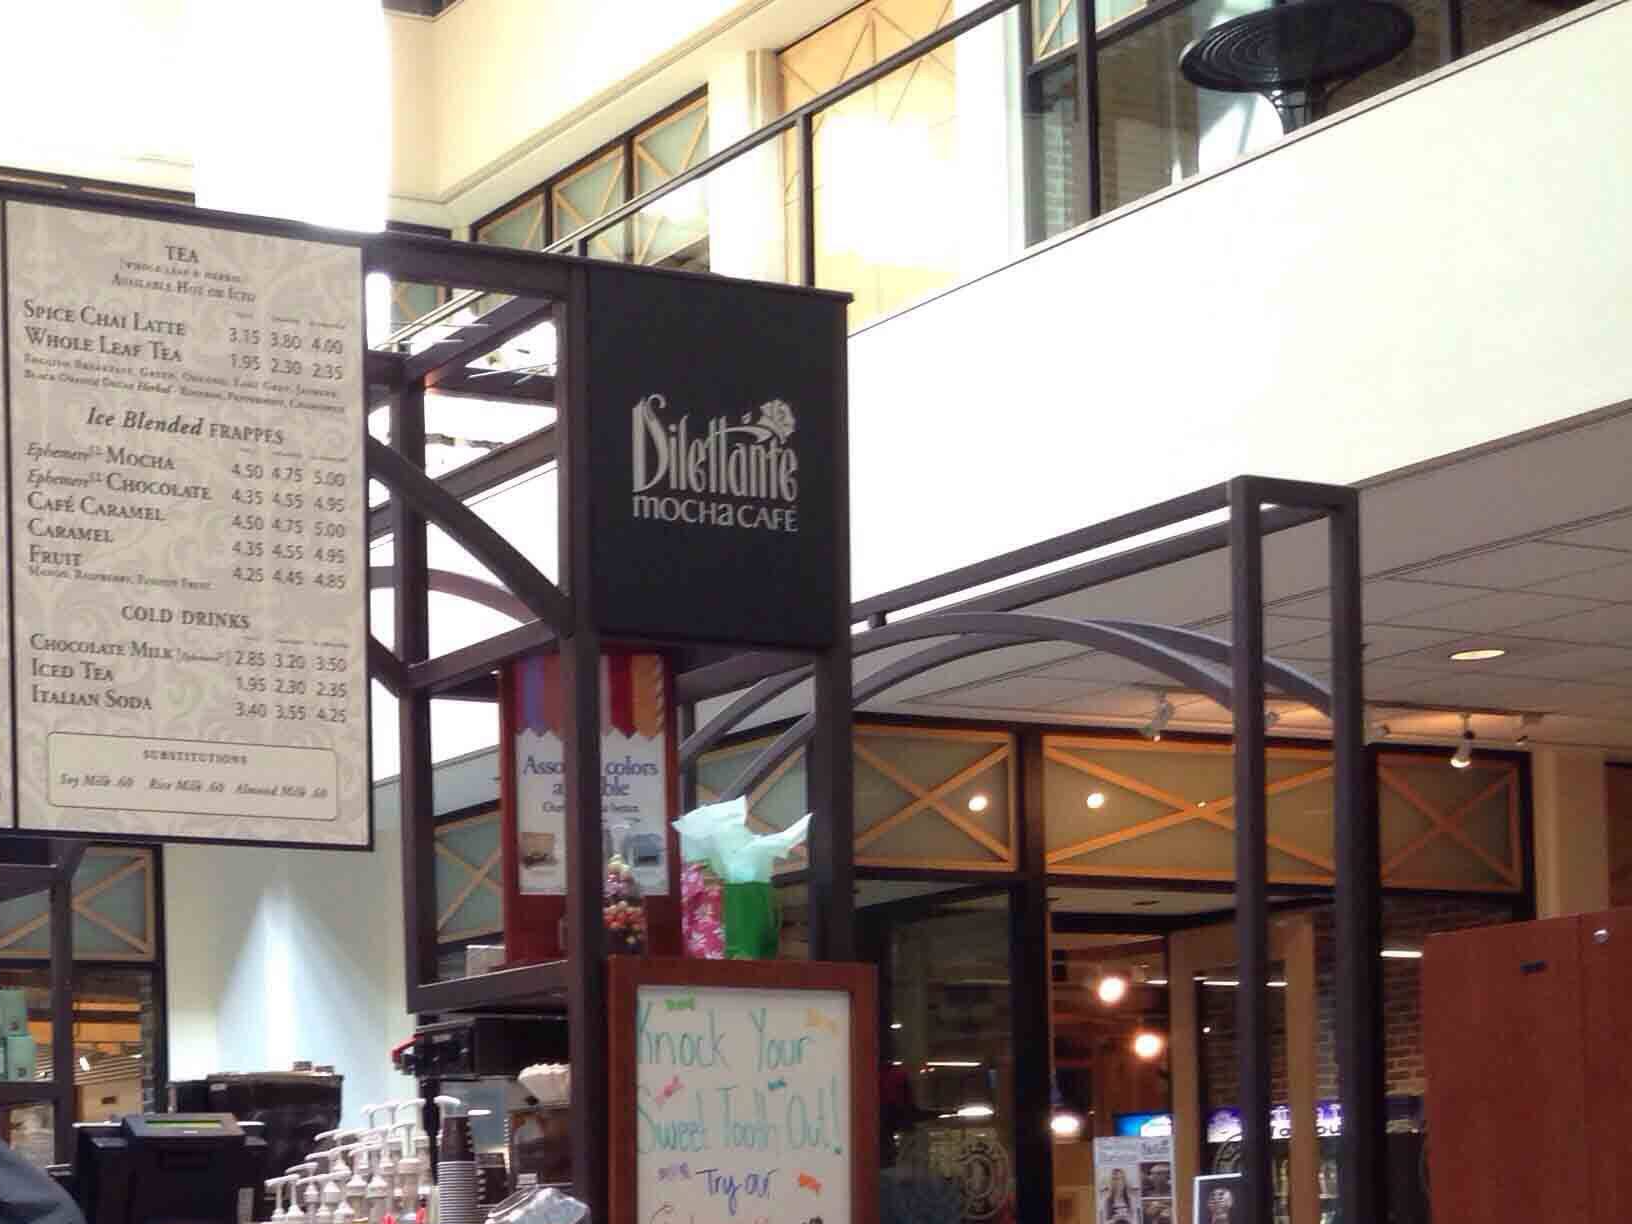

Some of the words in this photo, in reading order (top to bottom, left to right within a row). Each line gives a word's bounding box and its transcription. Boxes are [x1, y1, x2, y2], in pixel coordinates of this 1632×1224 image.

[165, 245, 200, 264] TEA
[24, 299, 75, 324] SPICE
[80, 305, 126, 330] CHAI
[133, 312, 187, 337] LATTE
[25, 326, 94, 351] WHOLE
[100, 335, 141, 357] LEAF
[151, 340, 182, 362] TEA
[86, 407, 113, 429] Ice
[123, 410, 204, 437] Blended
[209, 423, 284, 445] FRAPPES
[105, 446, 175, 471] MOCHA
[632, 393, 798, 501] Dilettante
[106, 473, 212, 500] CHOCOLATE
[28, 491, 75, 513] CAFÉ
[81, 496, 165, 521] CARAMEL
[28, 518, 113, 543] CARAMEL
[29, 545, 82, 567] FRUIT
[121, 606, 172, 623] COLD
[181, 610, 250, 630] DRINKS
[30, 633, 125, 656] CHOCOLATE
[130, 641, 172, 660] MILK
[32, 658, 74, 680] ICED
[80, 662, 113, 682] TEA
[32, 684, 100, 707] ITALIAN
[104, 690, 152, 711] SODA
[638, 1002, 728, 1067] Knock
[750, 1006, 812, 1070] Your
[696, 1168, 742, 1215] Try
